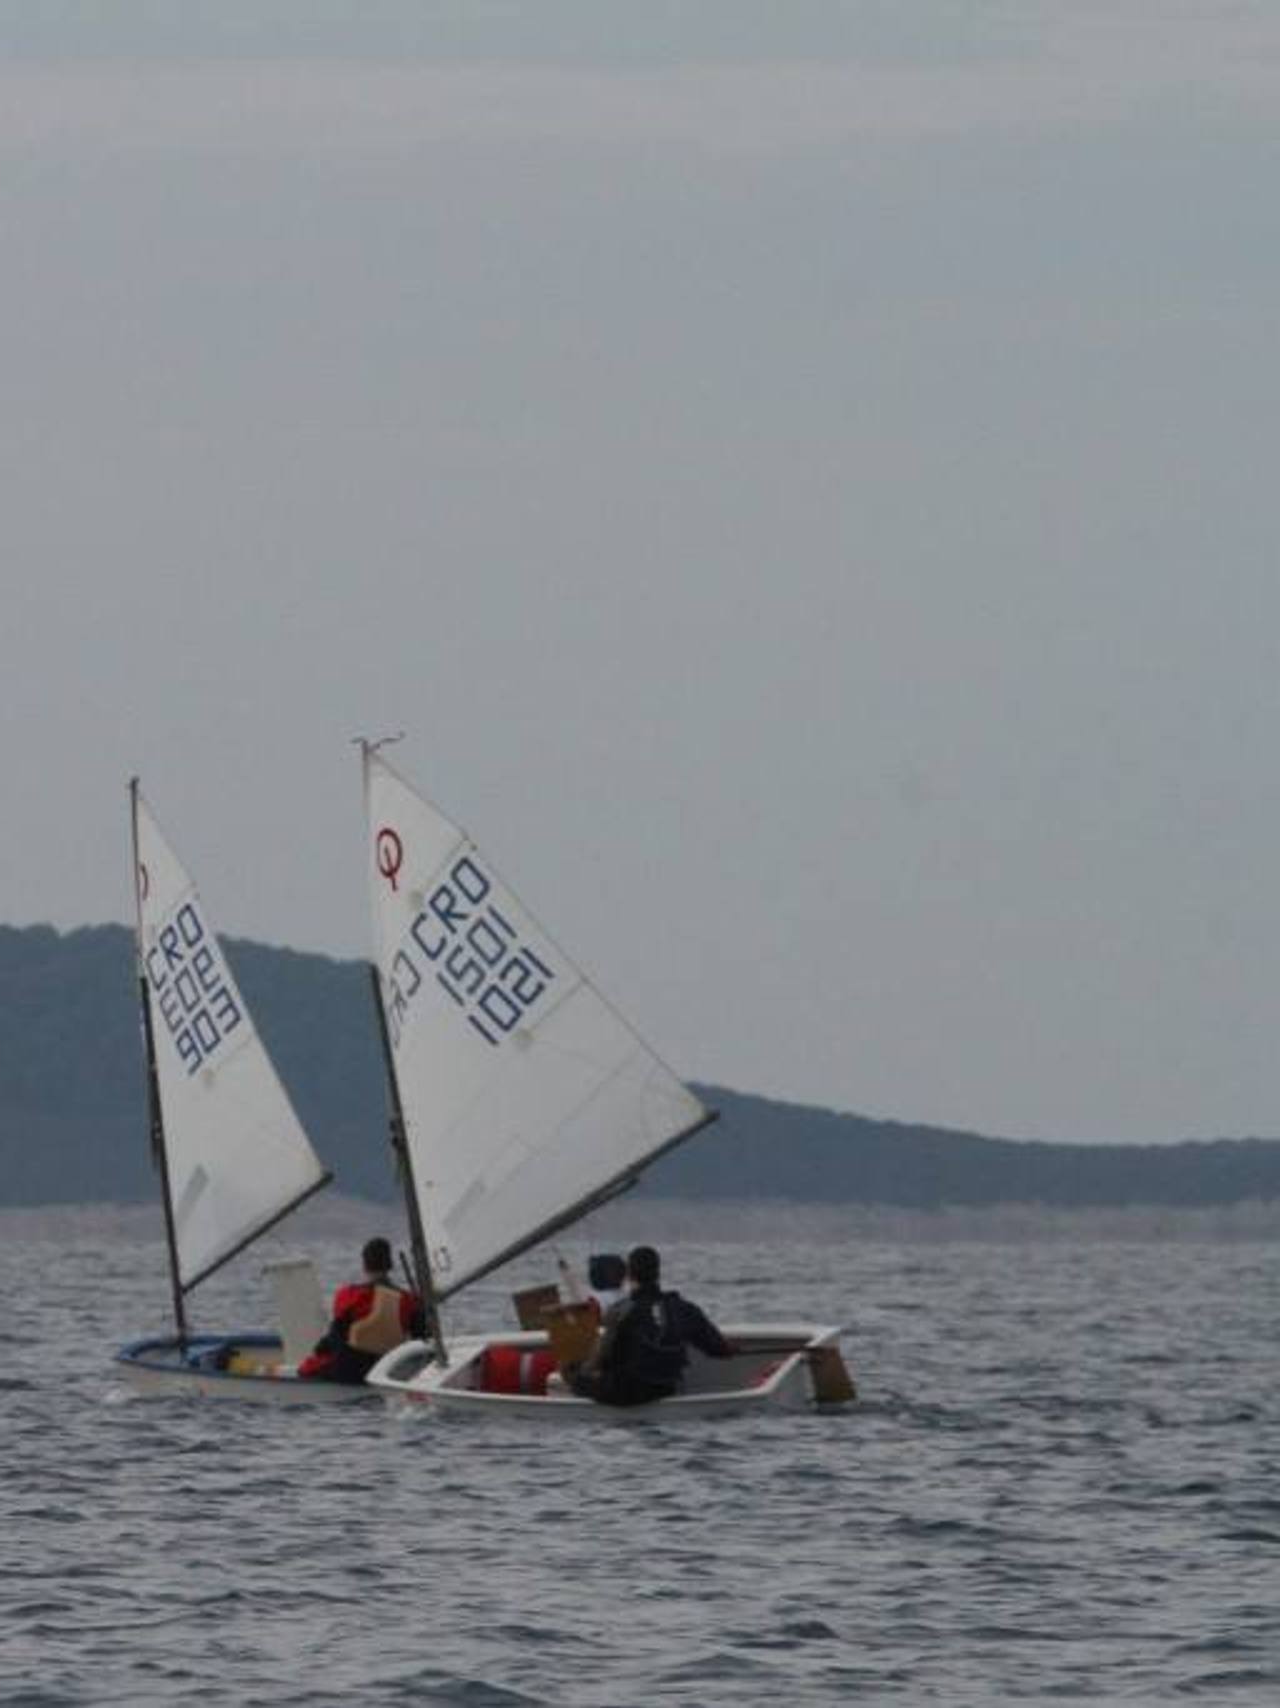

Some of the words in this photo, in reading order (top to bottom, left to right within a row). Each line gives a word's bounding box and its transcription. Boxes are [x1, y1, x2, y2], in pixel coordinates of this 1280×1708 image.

[146, 903, 204, 991] CRO
[410, 857, 491, 961] CRO
[175, 986, 242, 1077] 903
[467, 947, 557, 1046] 1021
